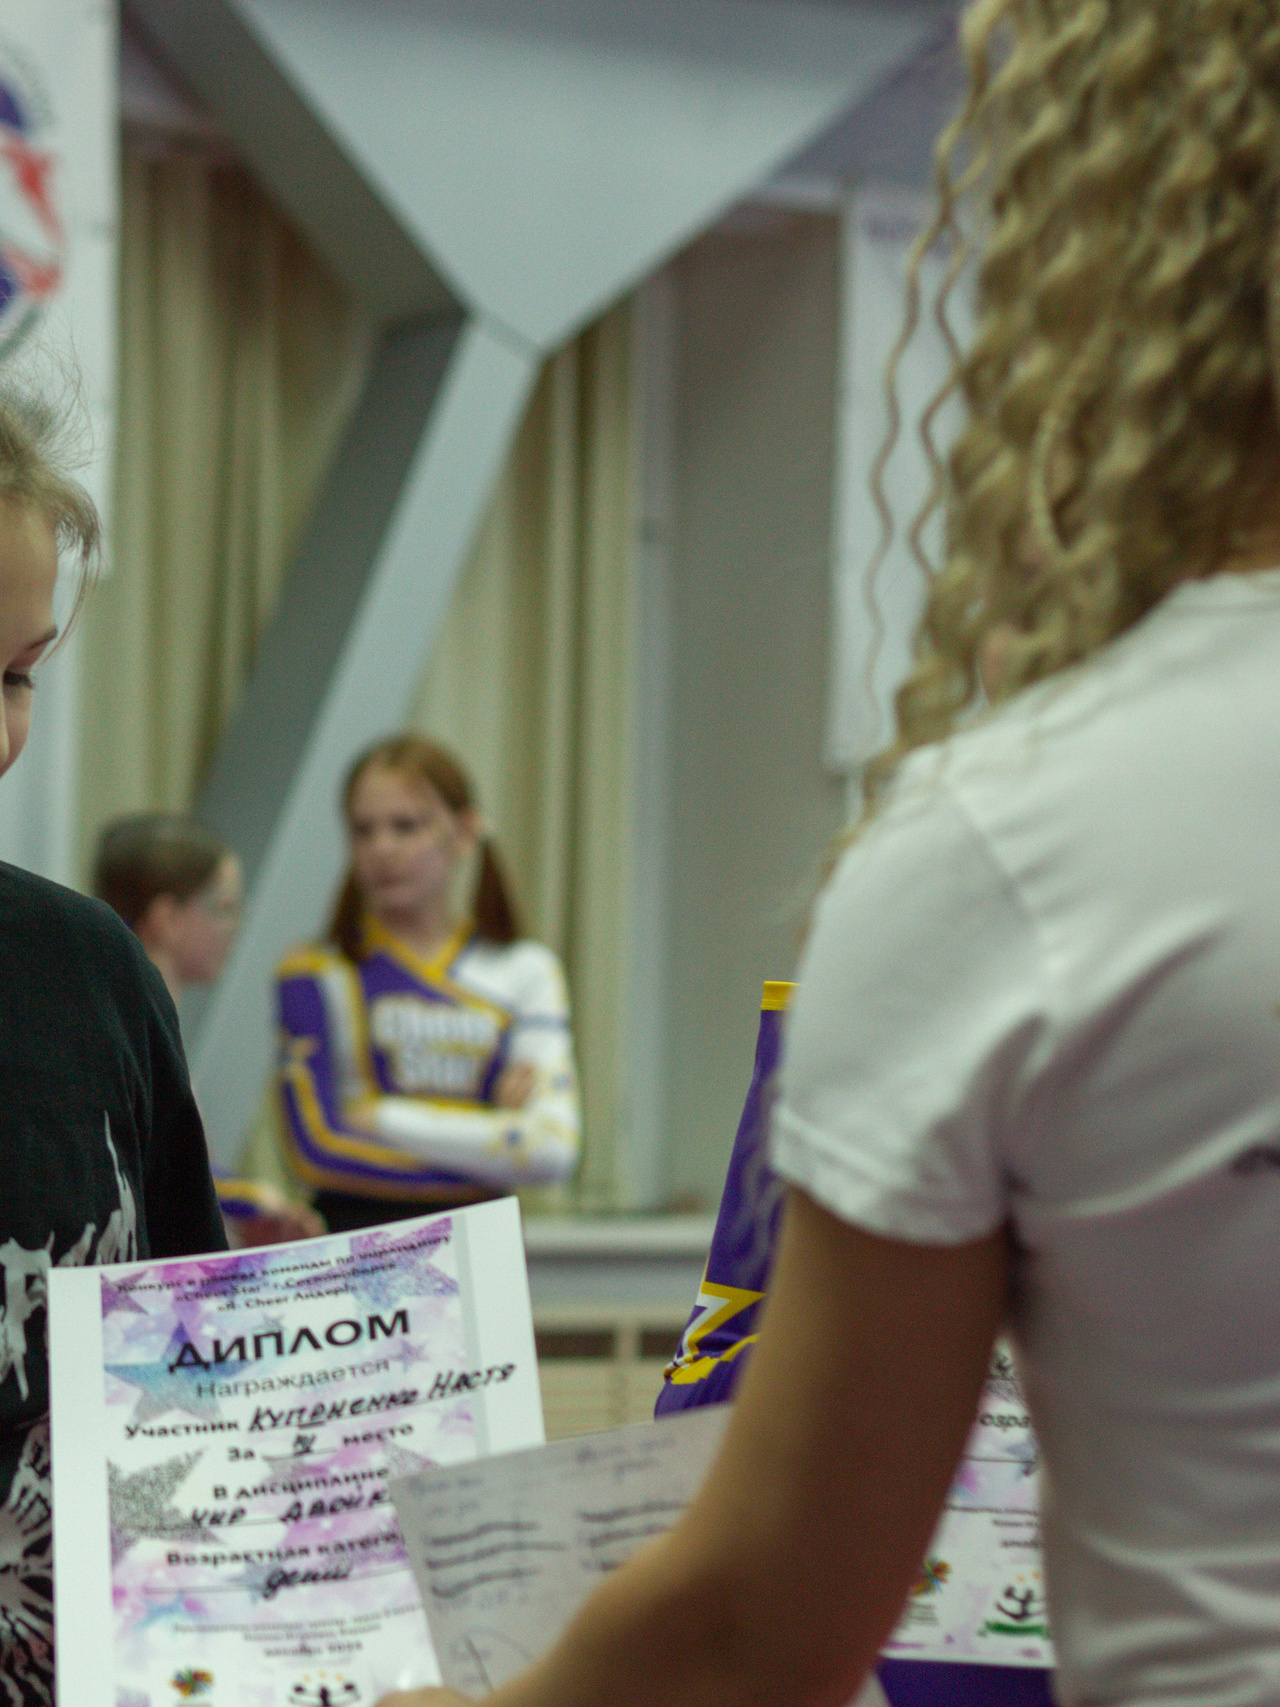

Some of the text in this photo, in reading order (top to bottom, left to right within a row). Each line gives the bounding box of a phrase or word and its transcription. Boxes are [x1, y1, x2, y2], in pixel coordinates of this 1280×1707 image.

[168, 1308, 411, 1373] ДИПЛОМ
[195, 1358, 391, 1399] Награждается
[124, 1419, 240, 1440] Участник
[227, 1446, 256, 1462] За
[342, 1423, 414, 1447] место
[213, 1485, 228, 1499] В
[236, 1467, 390, 1500] дисциплине
[166, 1546, 310, 1567] Возрастная
